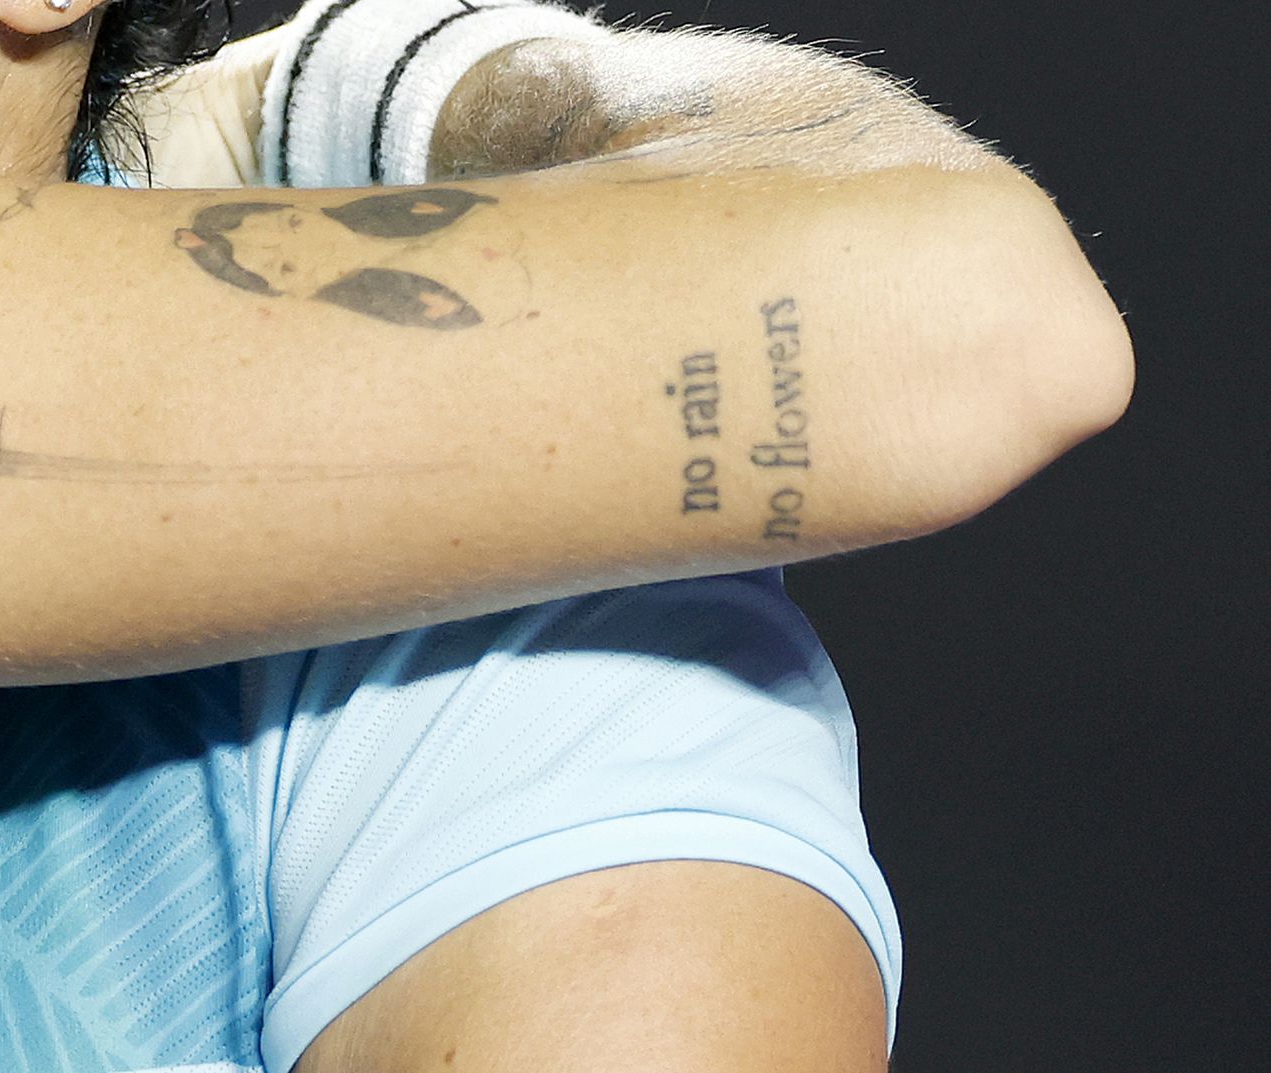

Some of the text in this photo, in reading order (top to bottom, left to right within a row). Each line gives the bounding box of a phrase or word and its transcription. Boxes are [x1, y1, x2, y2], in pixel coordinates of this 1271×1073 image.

[665, 351, 722, 514] no rain
[750, 297, 810, 541] no flowers
